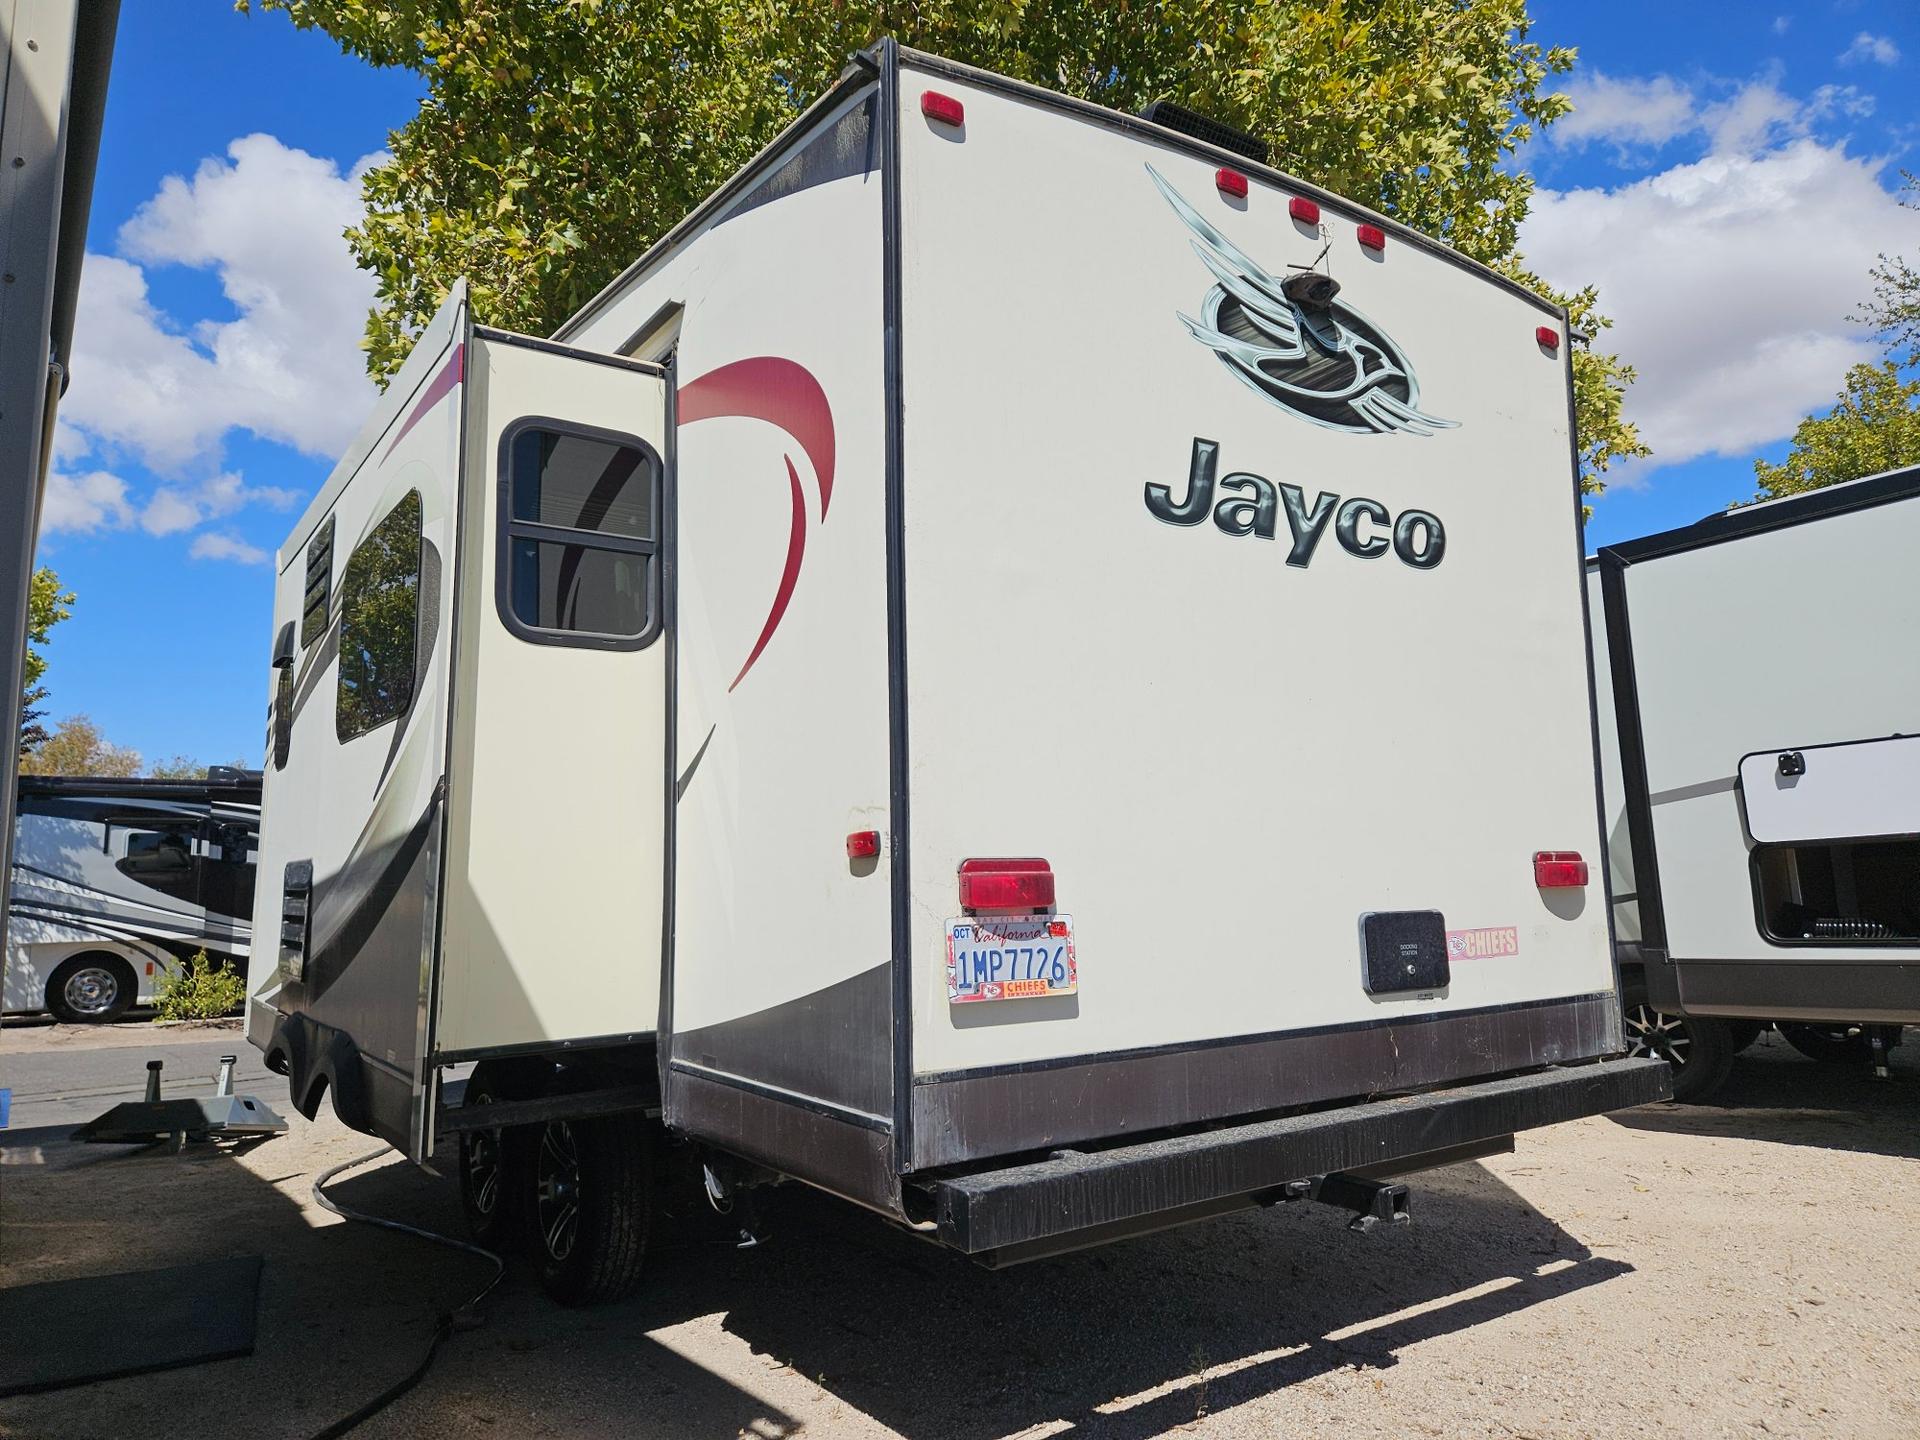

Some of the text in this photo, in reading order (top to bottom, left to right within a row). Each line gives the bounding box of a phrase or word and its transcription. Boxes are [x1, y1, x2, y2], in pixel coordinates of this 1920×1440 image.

[1144, 436, 1447, 570] Jayco
[953, 927, 970, 939] OCT
[973, 923, 1049, 948] California
[1464, 929, 1516, 957] CHIEFS
[958, 946, 1065, 989] 1MP7726
[1007, 980, 1047, 993] CHIEFS
